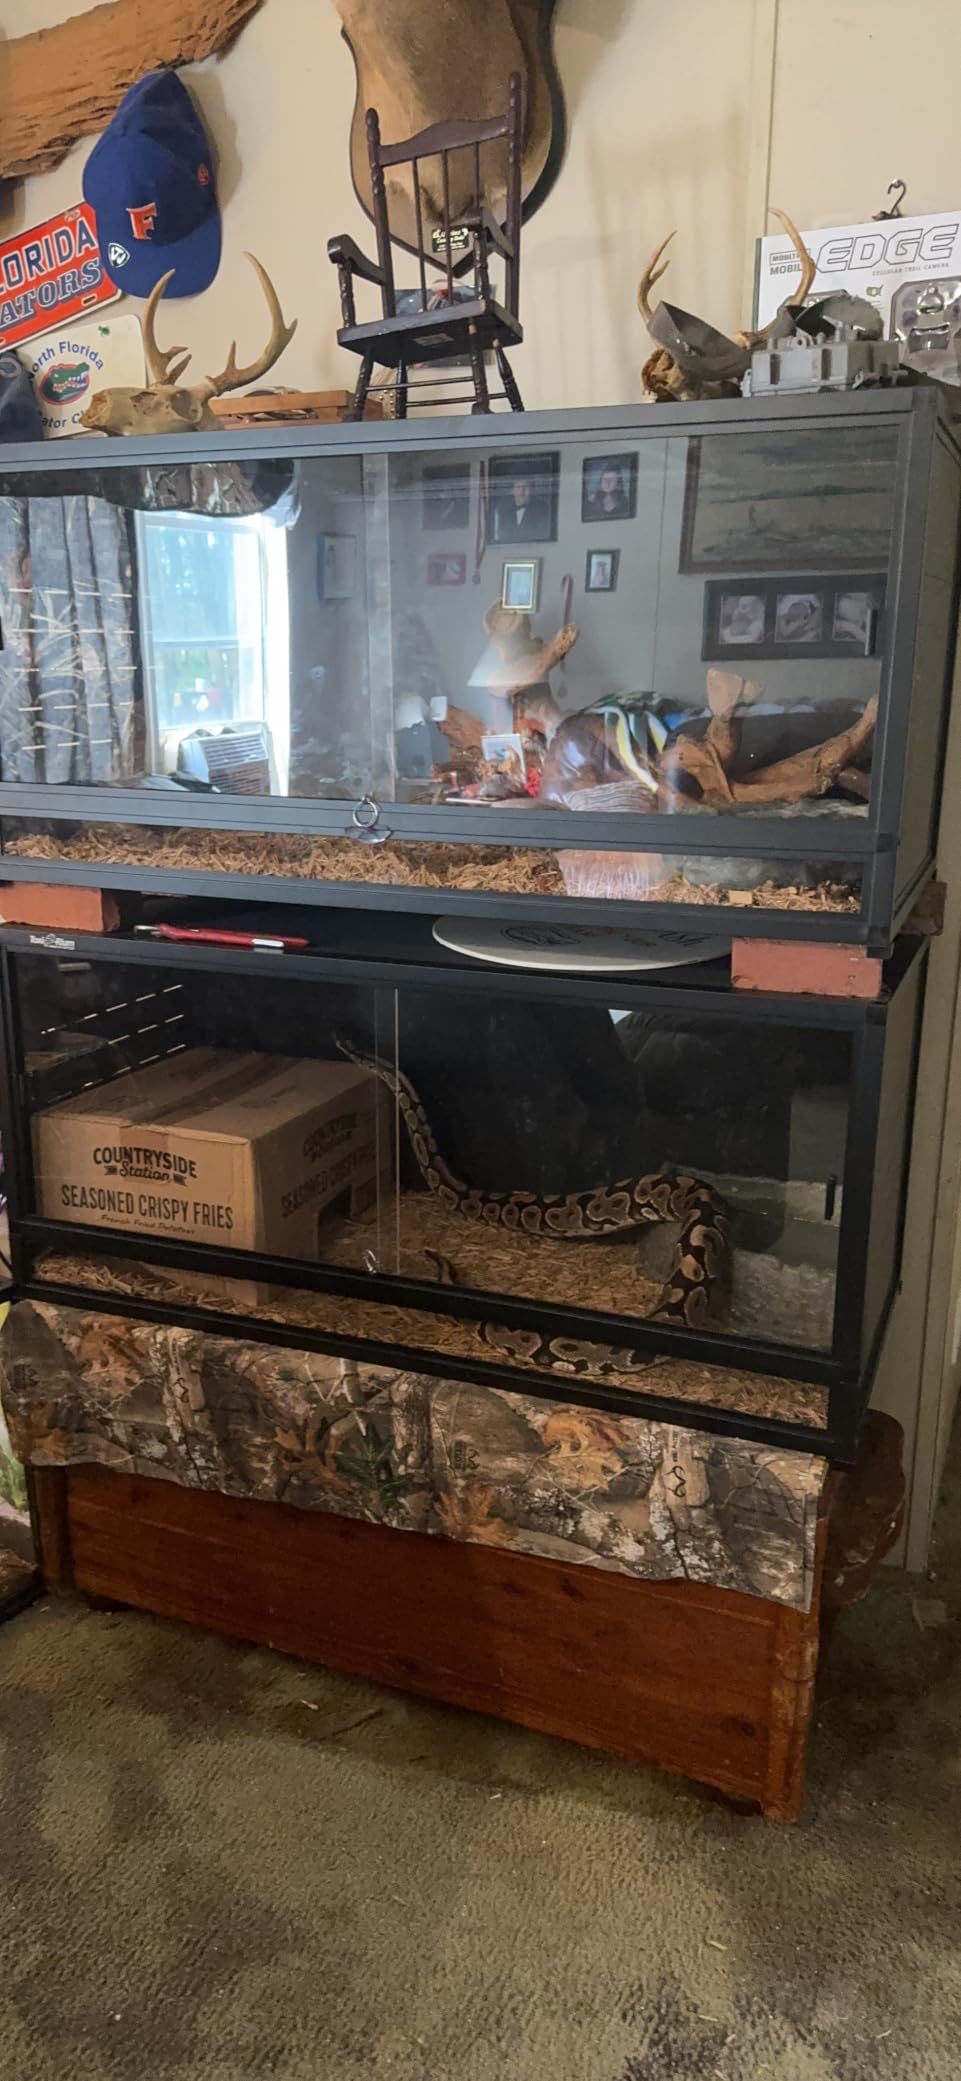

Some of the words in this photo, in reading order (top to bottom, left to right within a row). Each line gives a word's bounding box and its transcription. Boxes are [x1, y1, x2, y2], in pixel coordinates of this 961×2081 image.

[126, 202, 157, 240] F
[0, 217, 99, 294] ORIDA
[816, 224, 960, 273] EDGE
[770, 263, 804, 275] MOBIL
[0, 257, 102, 331] ATORS
[29, 347, 56, 378] orth
[59, 341, 104, 370] Florida
[39, 411, 66, 428] ator
[93, 1146, 198, 1179] COUNTRYSIDE
[119, 1160, 172, 1184] Station
[61, 1184, 134, 1215] SEASONED
[138, 1194, 189, 1223] CRISPY
[193, 1202, 234, 1230] FRIES
